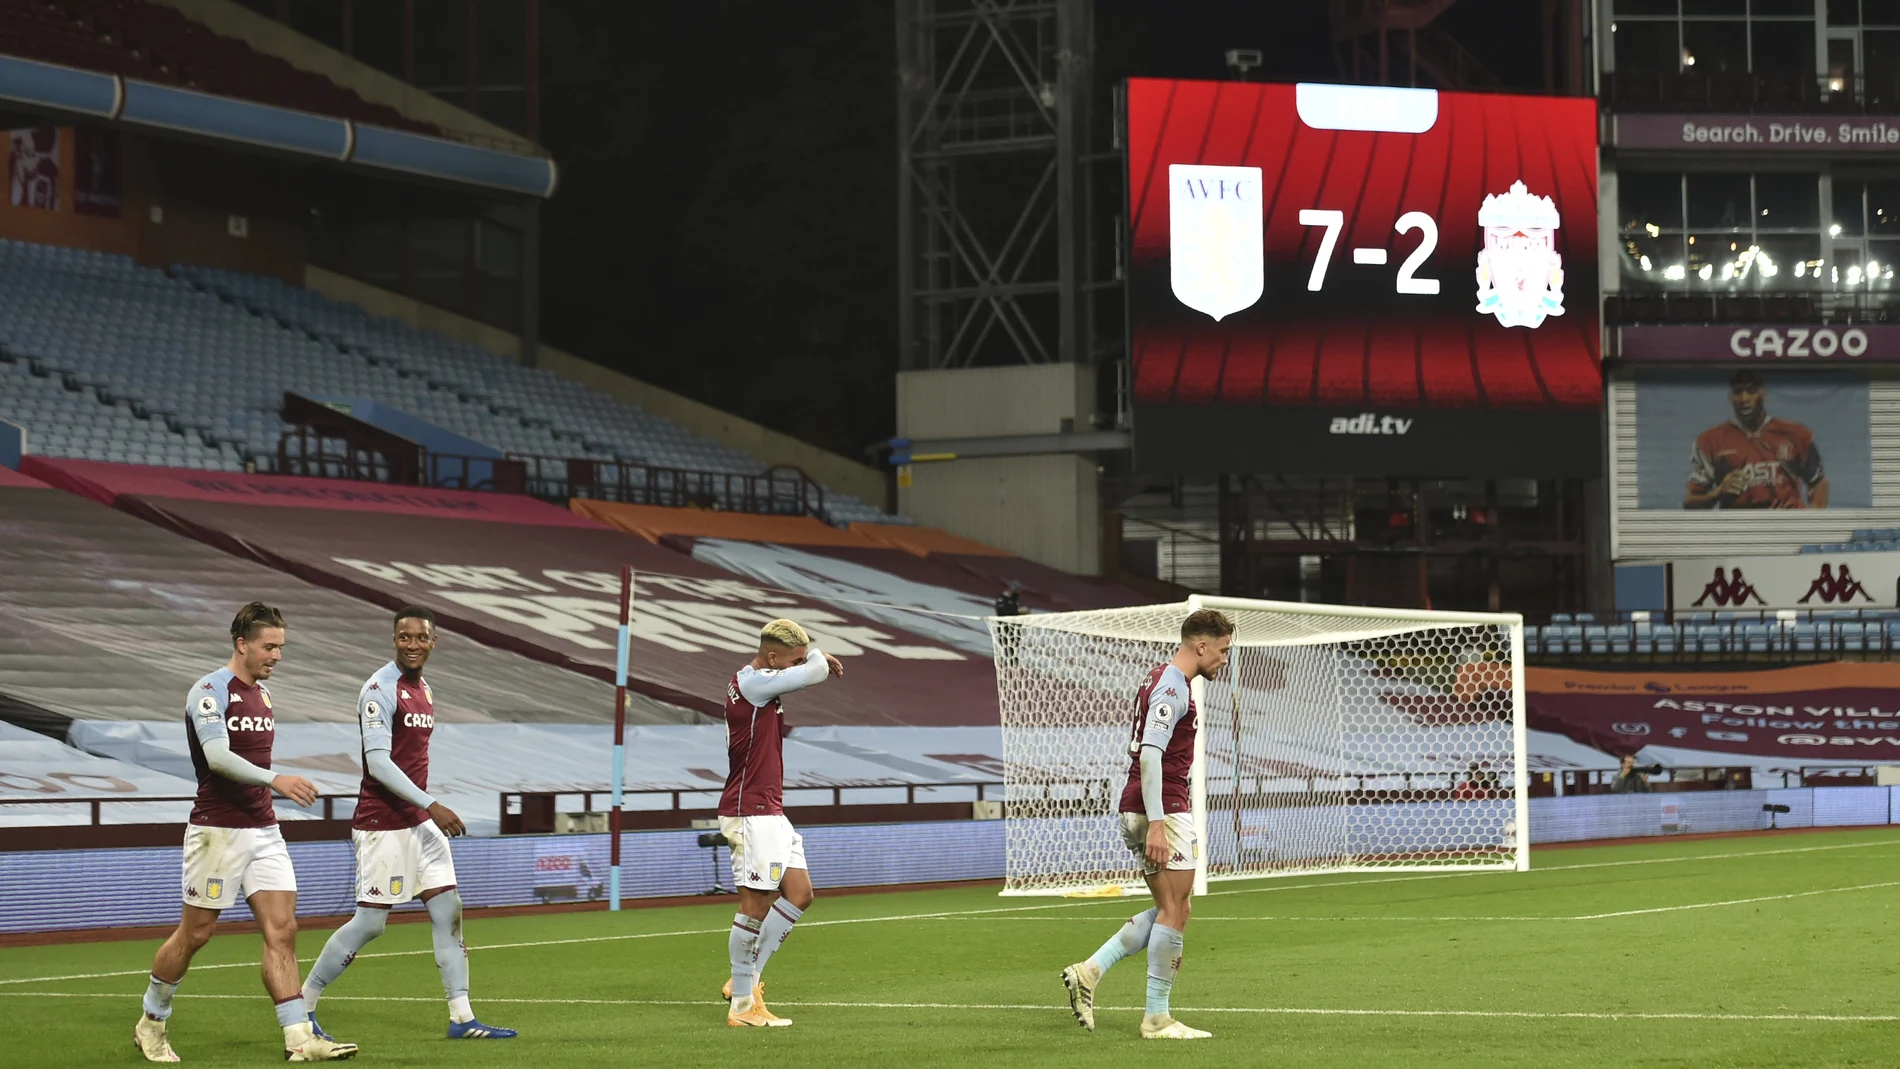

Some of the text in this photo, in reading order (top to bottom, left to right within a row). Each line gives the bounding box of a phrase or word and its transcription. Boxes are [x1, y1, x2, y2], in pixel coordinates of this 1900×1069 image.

[1683, 122, 1899, 143] Search. Drive. Smile
[1730, 328, 1868, 357] CAZOO
[1329, 413, 1413, 435] adi.tv
[330, 556, 799, 605] PART OF THE
[428, 590, 968, 661] PRIDE
[1653, 698, 1900, 718] ASTON VILL
[227, 716, 275, 732] CAZO
[403, 712, 434, 729] CAZO
[1701, 713, 1900, 730] Follow the
